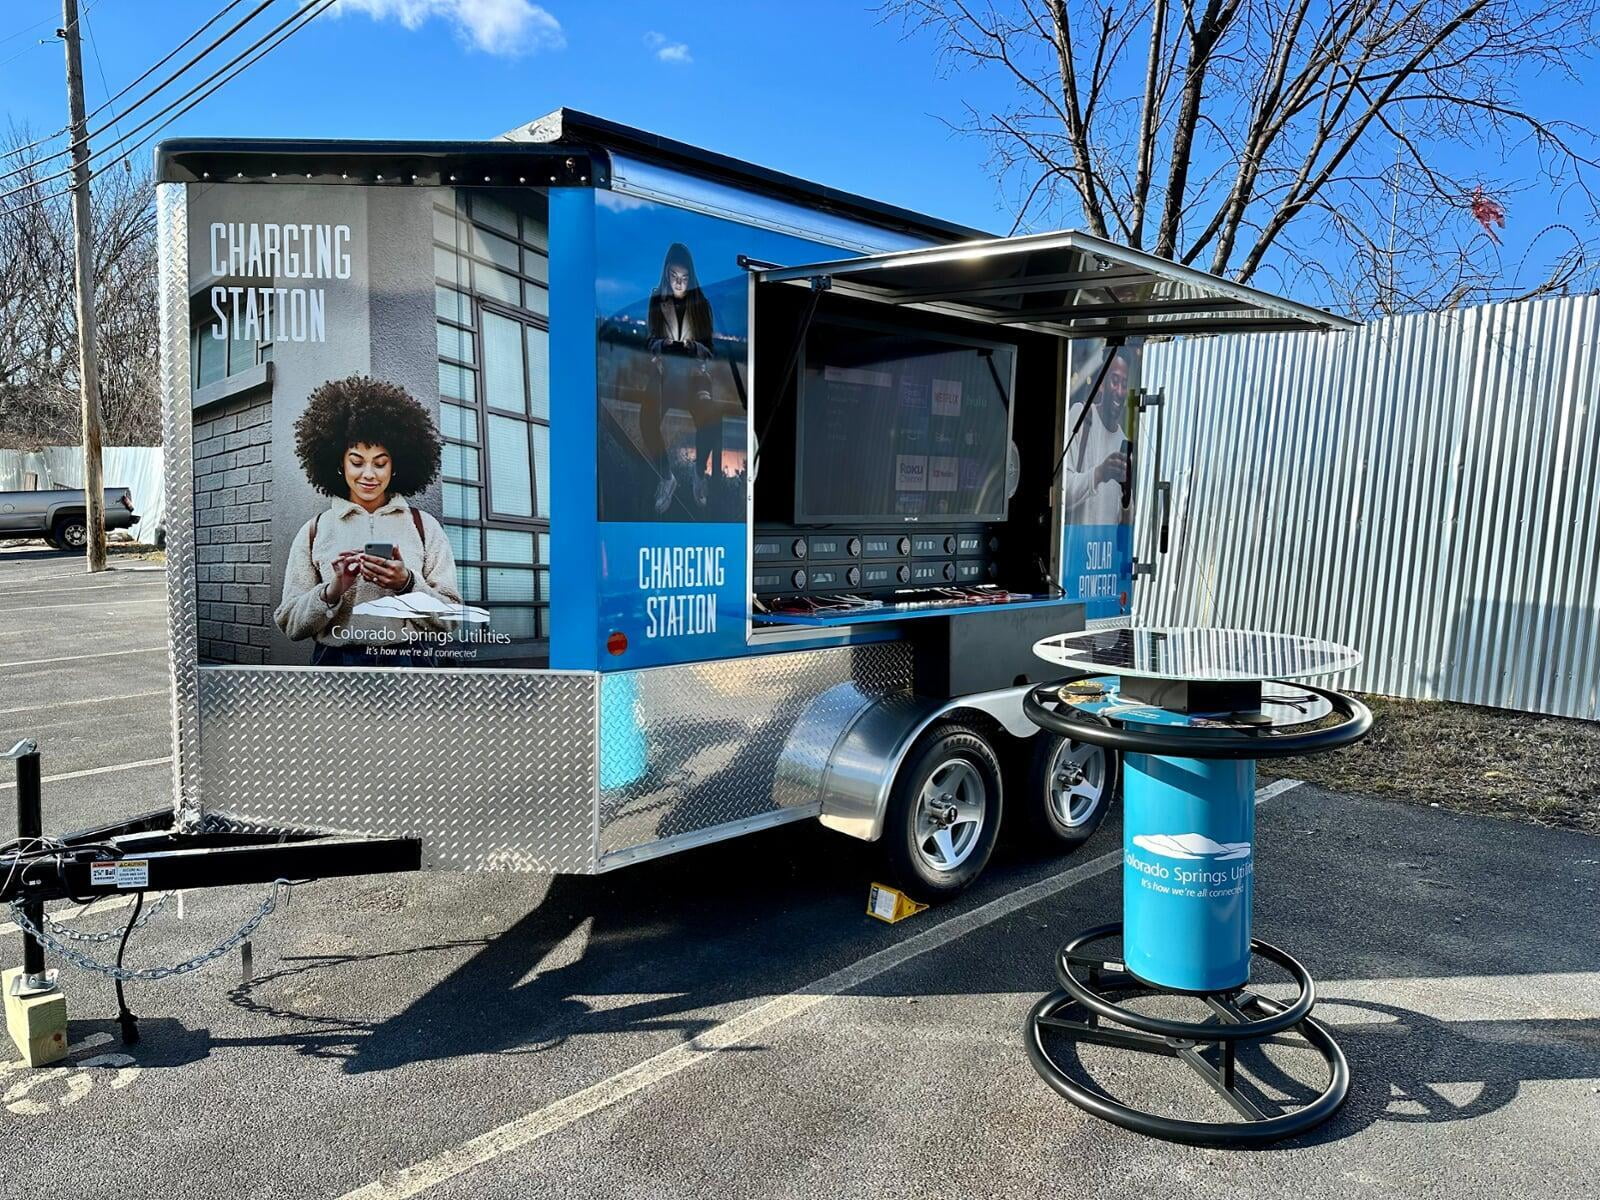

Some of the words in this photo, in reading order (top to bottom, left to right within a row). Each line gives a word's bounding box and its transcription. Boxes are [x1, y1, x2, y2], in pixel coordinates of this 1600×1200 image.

[210, 222, 351, 279] CHARGING
[211, 286, 326, 343] STATION
[639, 546, 725, 590] CHARGING
[1086, 541, 1112, 570] SOLAR
[1079, 573, 1117, 598] POWERED
[646, 593, 717, 638] STATION
[331, 625, 396, 641] Colorado
[401, 627, 453, 645] Springs
[458, 629, 511, 644] Utilities
[366, 646, 378, 655] It's
[380, 646, 397, 656] how
[400, 647, 421, 657] we're
[423, 647, 433, 657] all
[435, 648, 477, 658] connected
[1141, 877, 1152, 889] It's
[1152, 881, 1169, 894] how
[1171, 887, 1196, 897] we're
[1196, 888, 1207, 897] all
[1174, 866, 1228, 886] Springs
